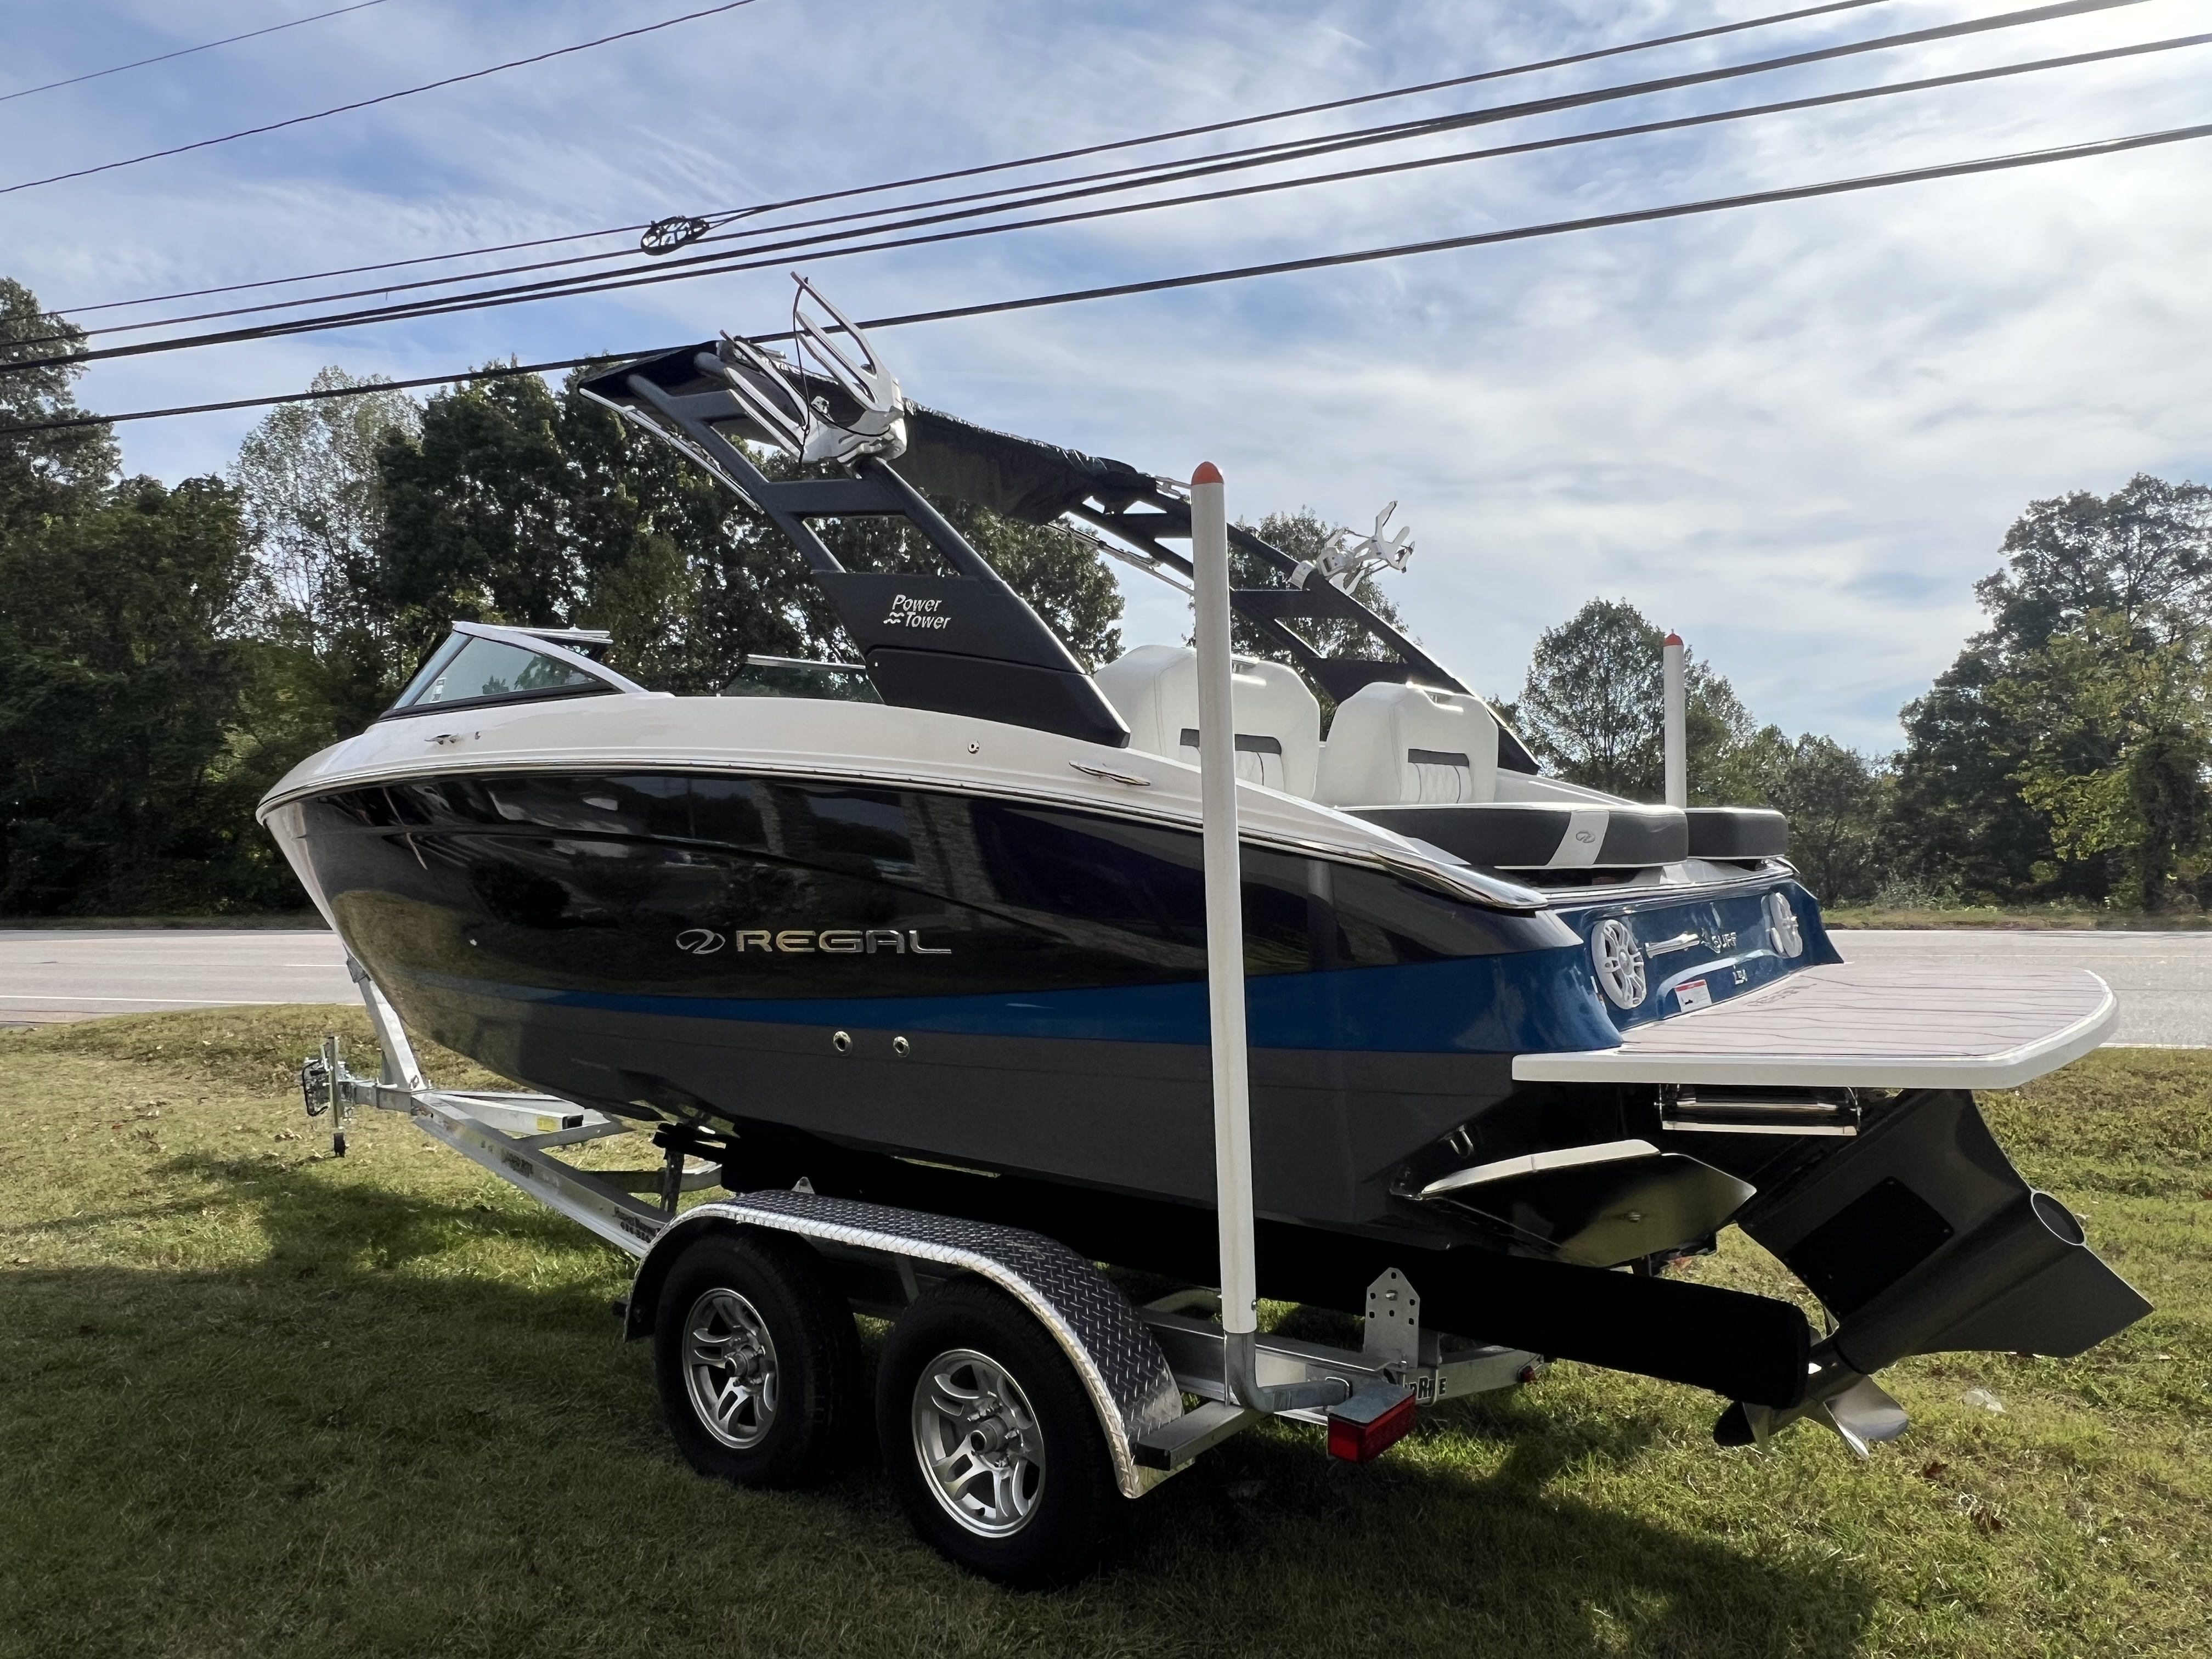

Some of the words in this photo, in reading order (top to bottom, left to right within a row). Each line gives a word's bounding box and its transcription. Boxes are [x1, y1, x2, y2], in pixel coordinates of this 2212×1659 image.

[892, 594, 942, 612] Power
[905, 611, 951, 629] Tower
[736, 929, 951, 953] REGAL
